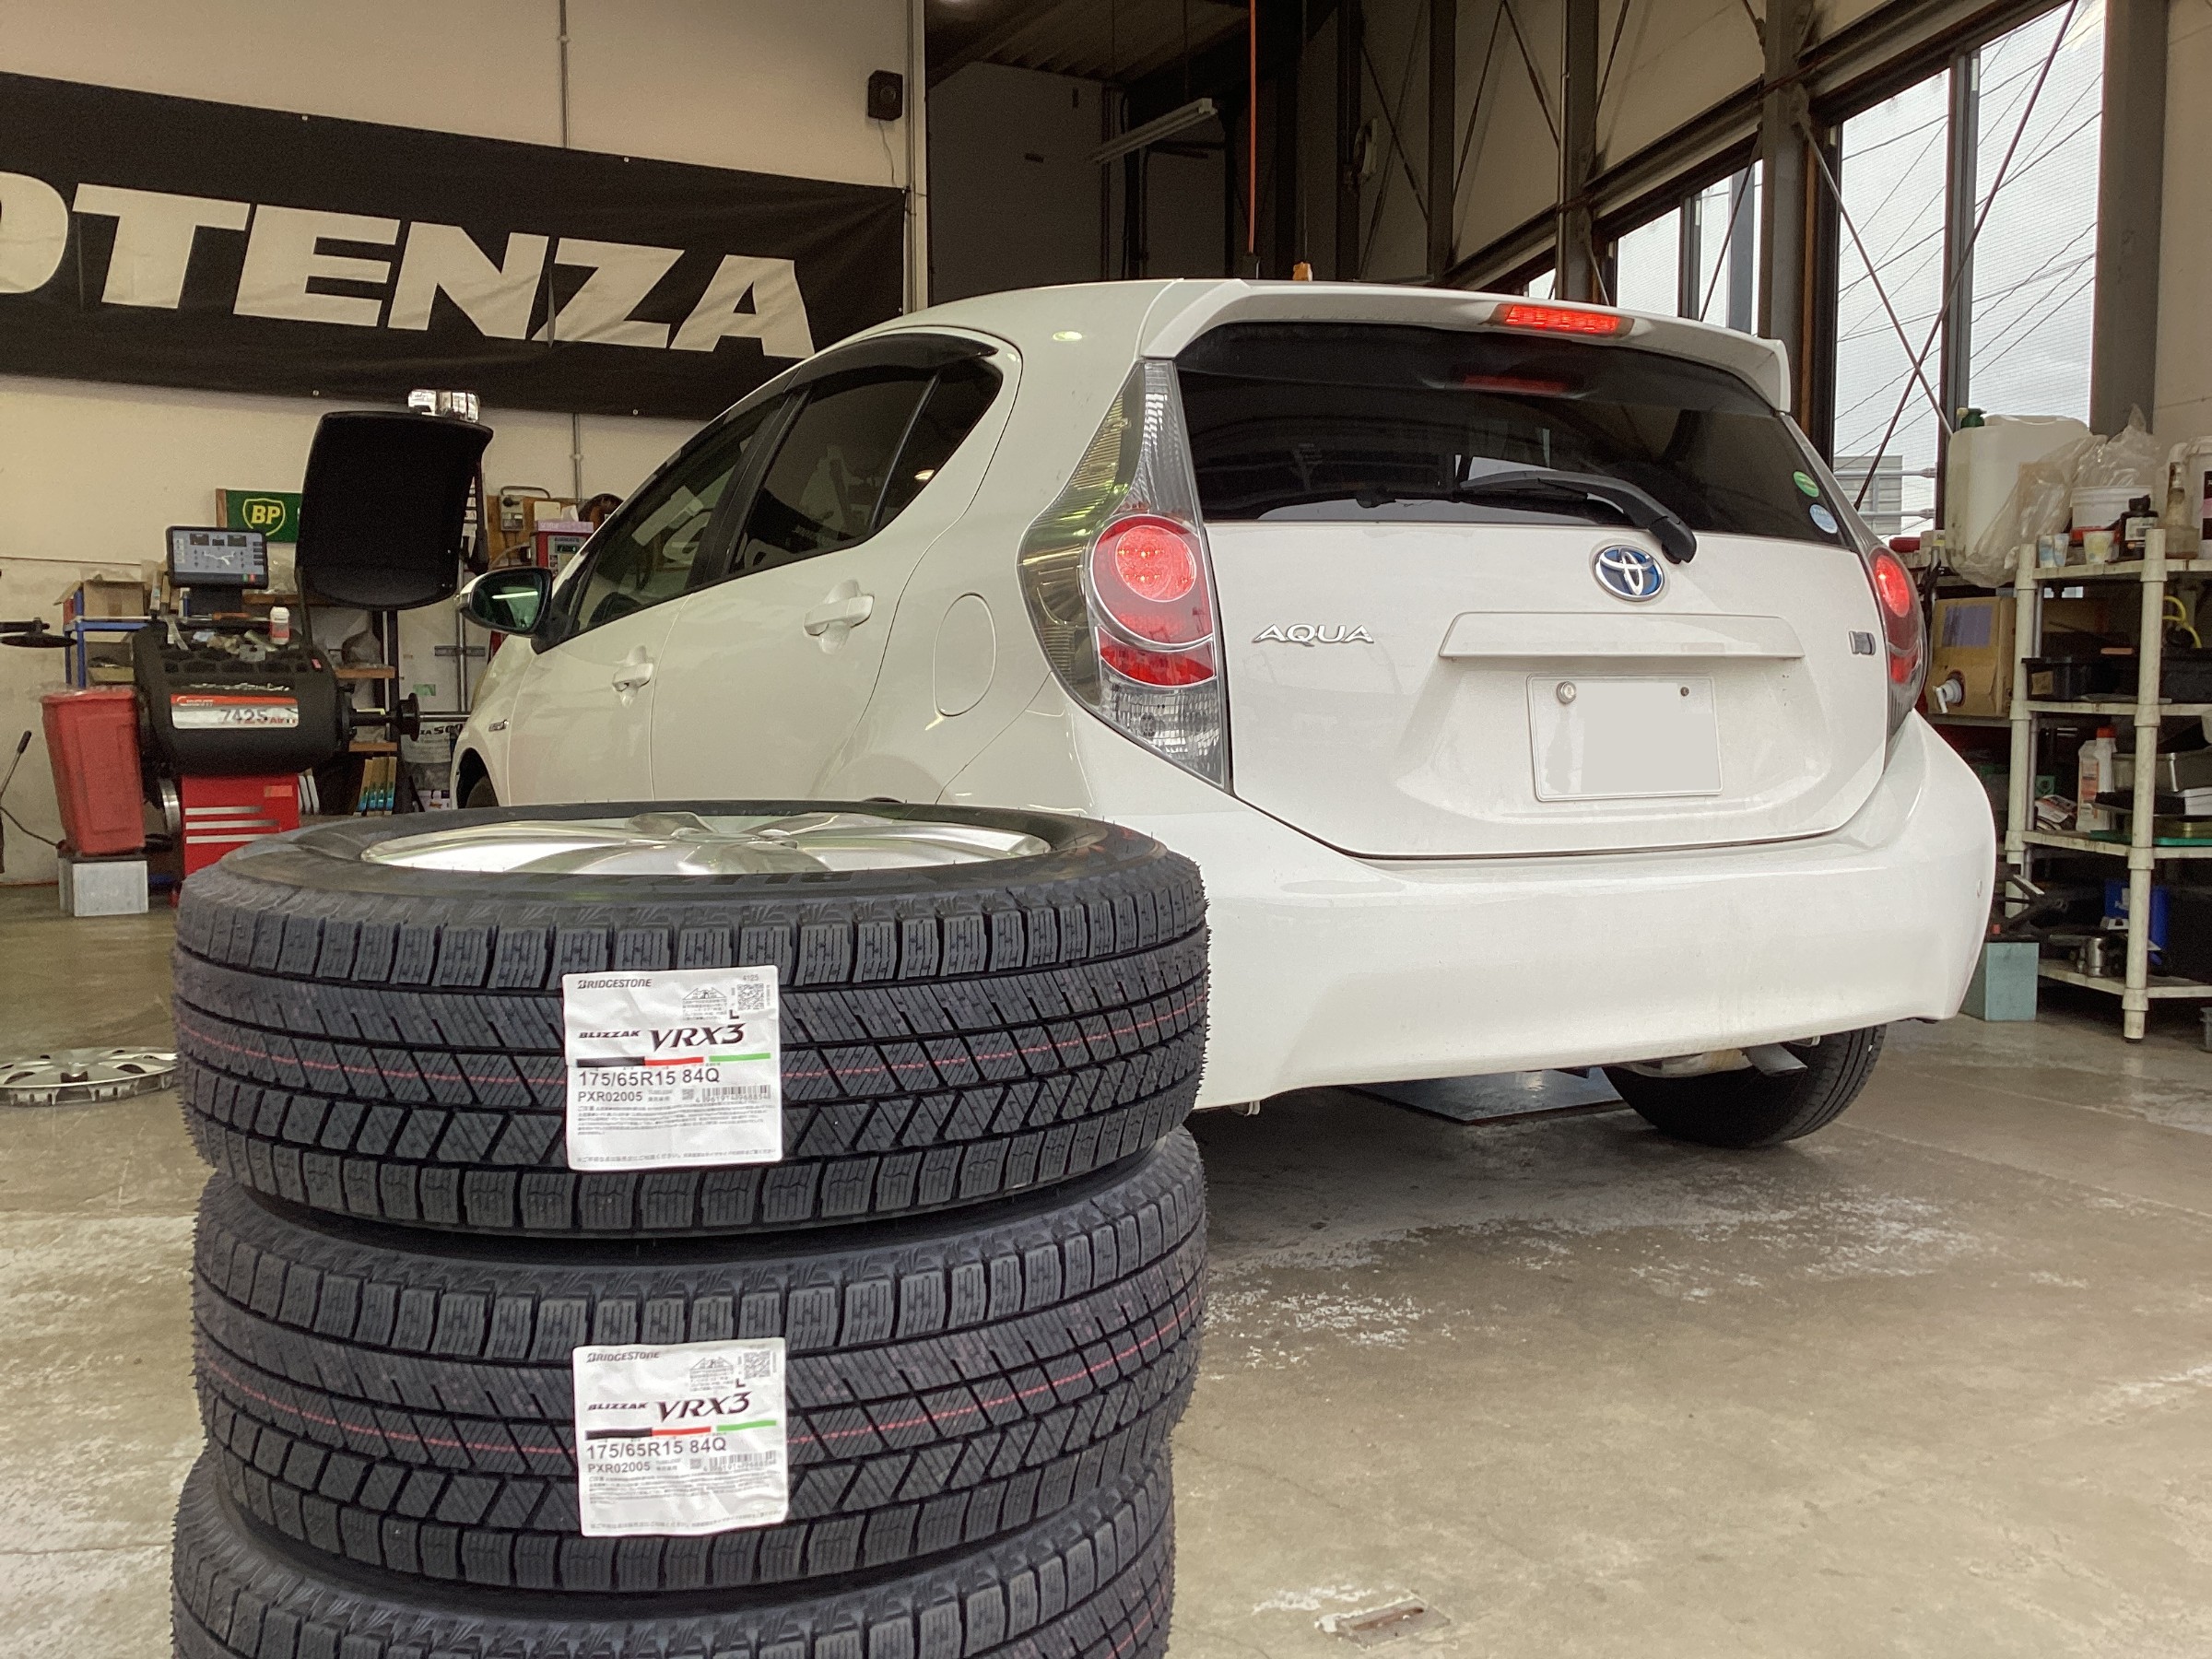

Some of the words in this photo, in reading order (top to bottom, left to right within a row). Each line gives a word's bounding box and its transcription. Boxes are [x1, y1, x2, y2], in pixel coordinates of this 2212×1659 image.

[251, 505, 280, 524] BP
[1252, 624, 1374, 647] AQUA
[577, 979, 653, 989] BRIDGESTONE
[729, 1009, 740, 1019] L
[578, 1030, 641, 1039] BLIZZAK
[648, 1023, 747, 1052] VRX3
[579, 1070, 676, 1087] 175/65R15
[682, 1067, 720, 1083] 84Q
[578, 1091, 642, 1102] PXR02005
[586, 1351, 660, 1363] BRIDGESTONE
[735, 1378, 746, 1388] L
[586, 1401, 648, 1411] BLIZZAK
[656, 1391, 752, 1423] VRX3
[586, 1441, 683, 1460] 175/65R15
[689, 1437, 726, 1453] 84Q
[587, 1461, 651, 1473] PXR02005
